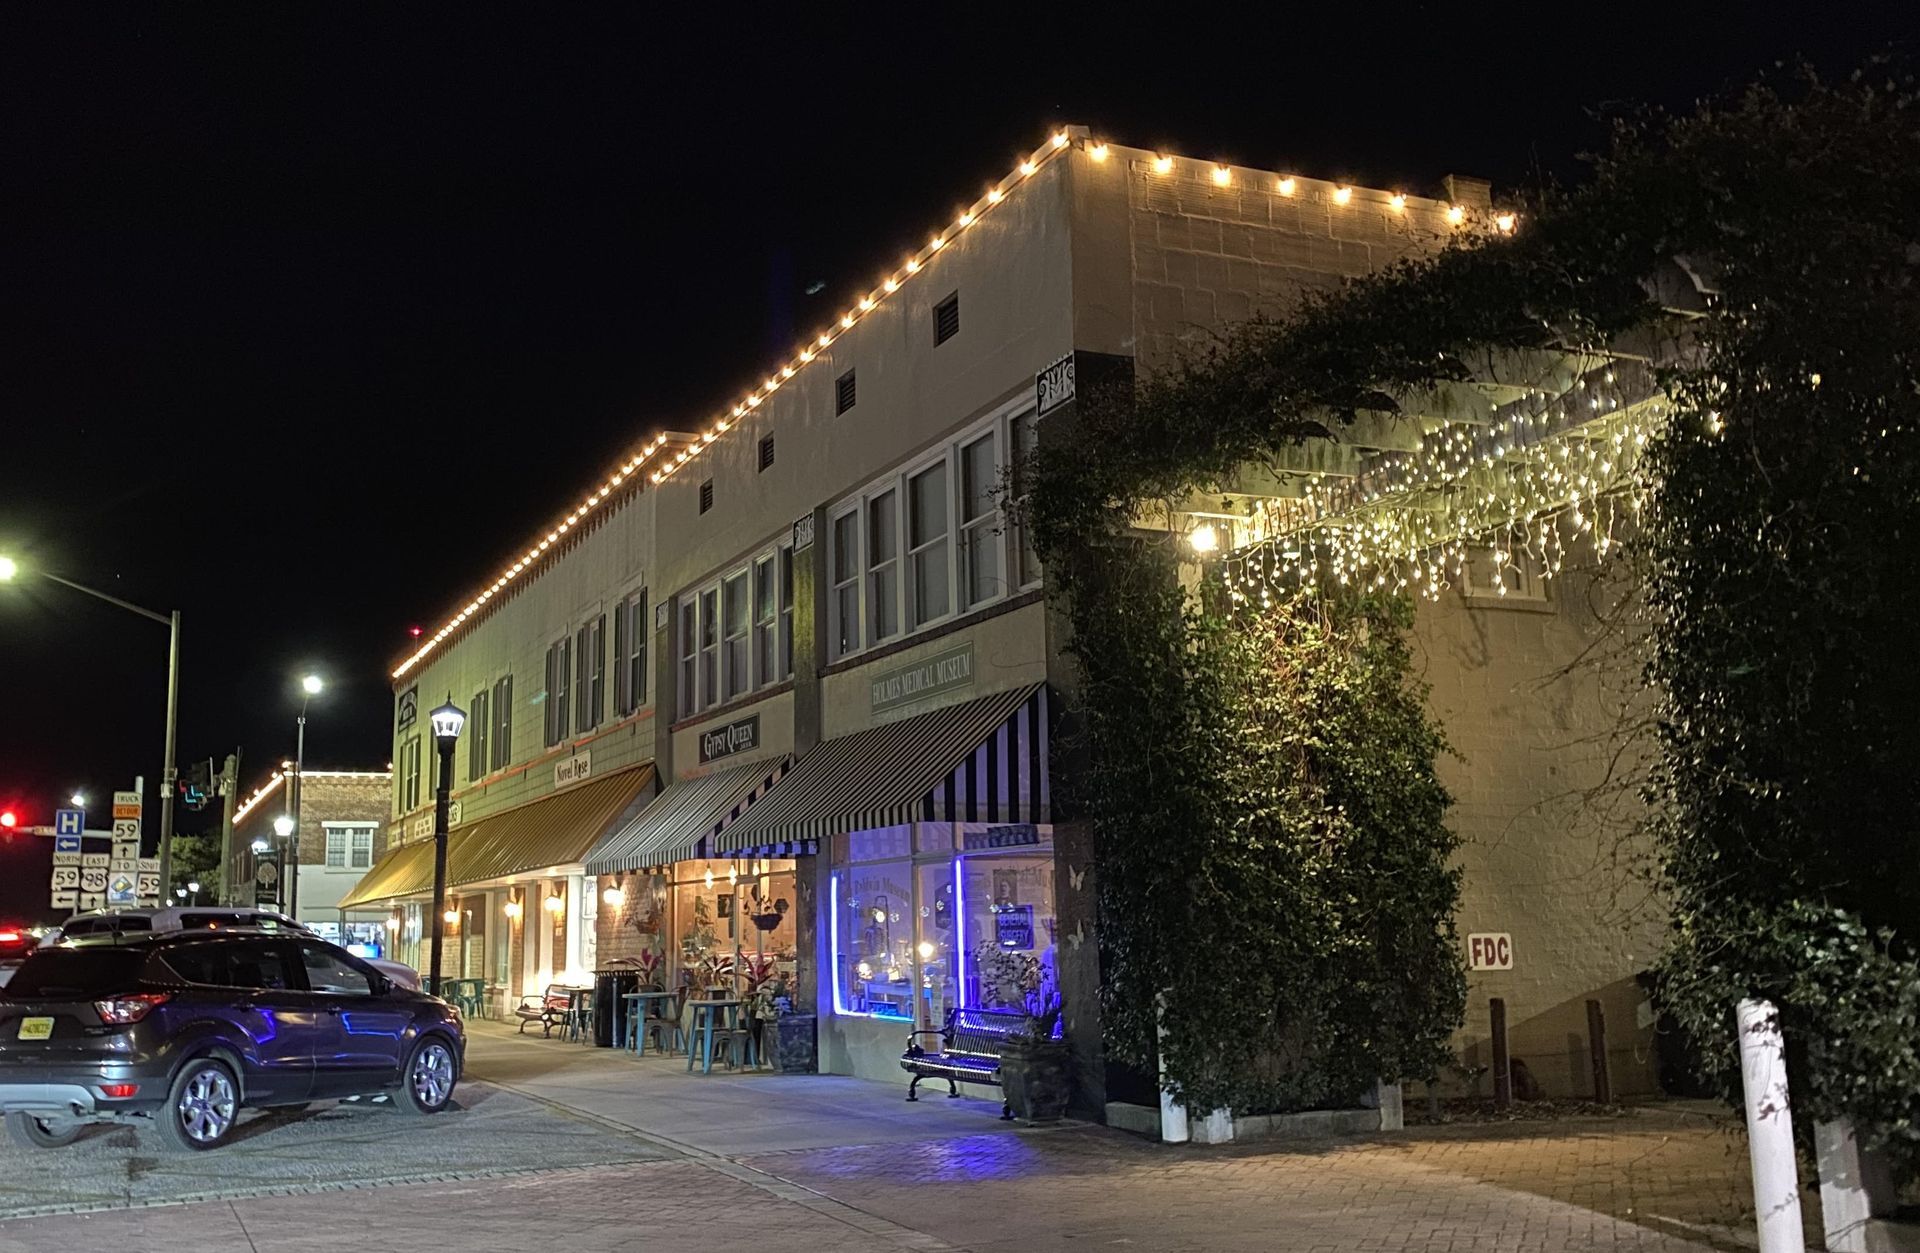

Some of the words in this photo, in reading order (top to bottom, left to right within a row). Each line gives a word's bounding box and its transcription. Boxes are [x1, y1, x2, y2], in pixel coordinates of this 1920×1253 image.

[872, 676, 900, 705] HOLMES
[902, 664, 935, 696] MEDICAL
[937, 652, 970, 685] MUSEUM
[704, 732, 726, 760] GYPSY
[727, 723, 753, 753] QUEEN
[556, 760, 573, 783] Novel
[116, 807, 138, 815] DETOUR
[61, 813, 79, 833] H
[115, 823, 137, 838] 59
[55, 855, 80, 864] NORTH
[86, 857, 106, 865] EAST
[117, 862, 131, 870] TO
[139, 861, 160, 870] SOUT
[55, 871, 77, 886] 59
[85, 873, 104, 887] 98
[139, 877, 160, 892] 59
[1472, 936, 1509, 966] FDC
